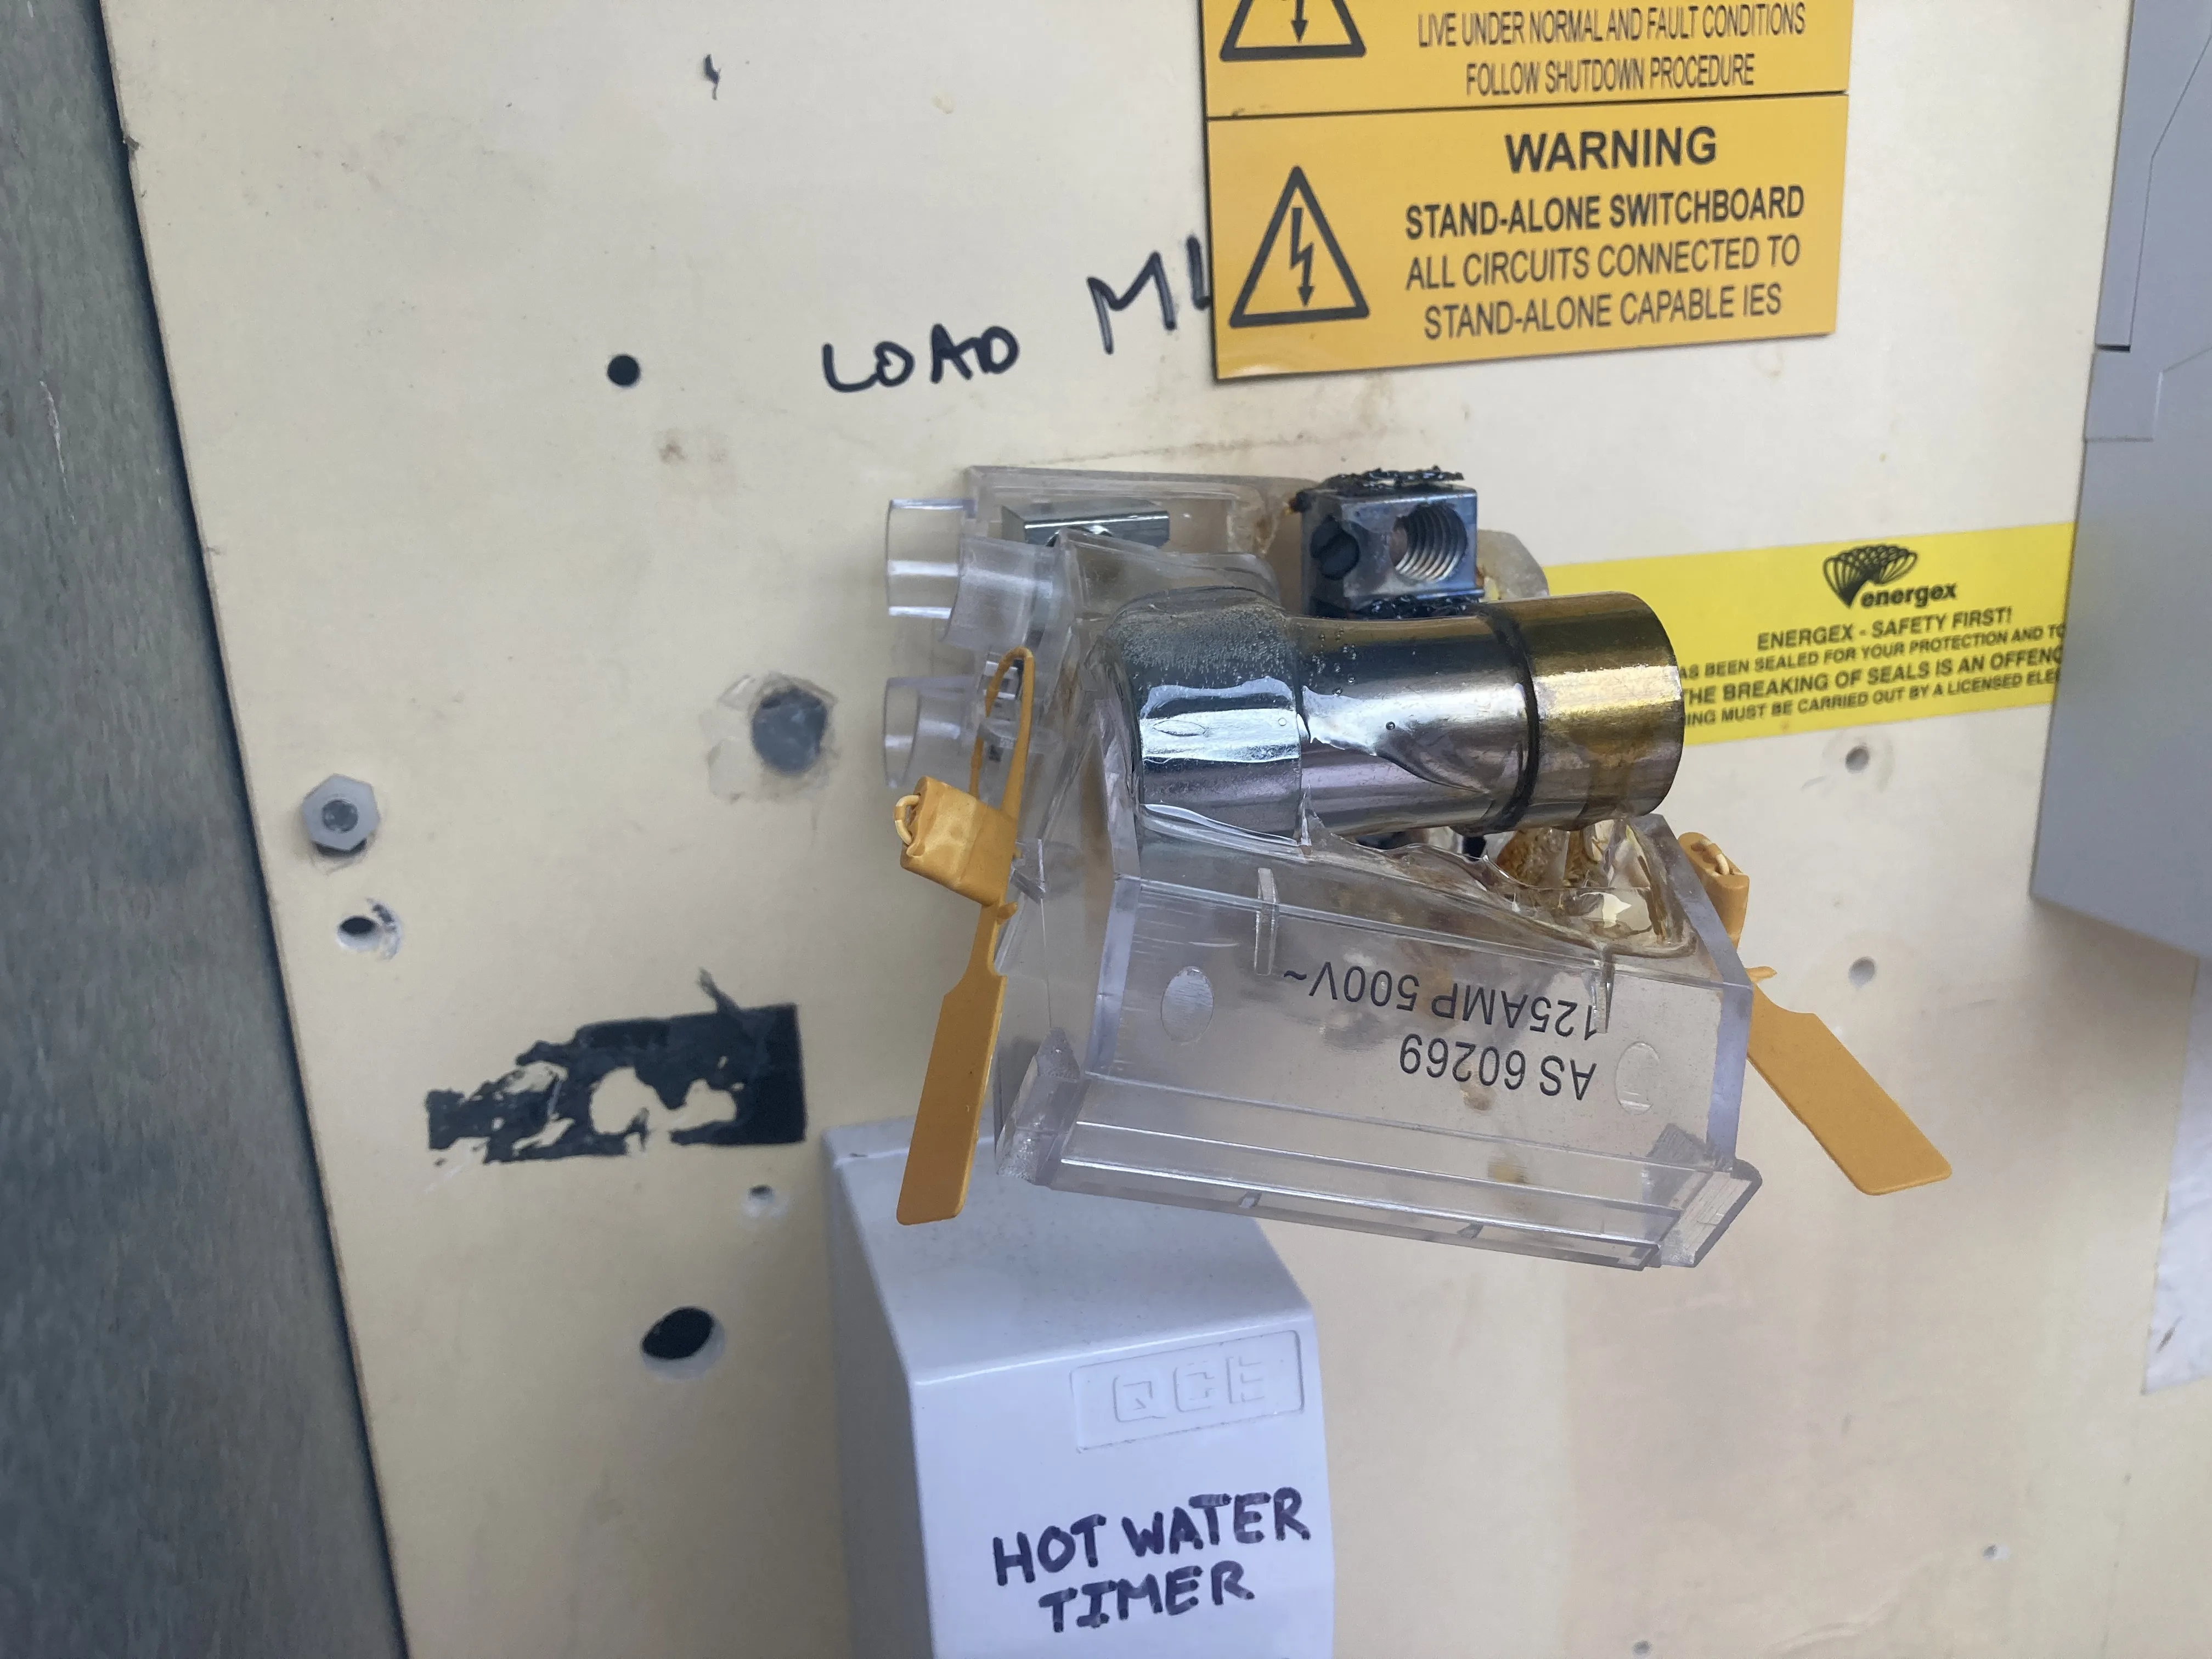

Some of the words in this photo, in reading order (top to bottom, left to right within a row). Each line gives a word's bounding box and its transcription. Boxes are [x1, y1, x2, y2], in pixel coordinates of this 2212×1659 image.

[1418, 12, 1457, 47] LIVE
[1462, 11, 1525, 46] UNDER
[1530, 8, 1604, 44] NORMAL
[1605, 7, 1643, 42] AND
[1647, 5, 1699, 40] FAULT
[1702, 2, 1805, 38] CONDITIONS
[1466, 60, 1540, 96] FOLLOW
[1545, 57, 1644, 93] SHUTDOWN
[1650, 53, 1754, 89] PROCEDURE
[1504, 125, 1716, 173] WARNING
[1405, 195, 1600, 240] STAND-ALONE
[1610, 184, 1804, 229] SWITCHBOARD
[1405, 256, 1455, 290] ALL
[1463, 246, 1589, 286] CIRCUITS
[1598, 236, 1759, 278] CONNECTED
[1767, 233, 1800, 267] TO
[1424, 294, 1612, 340] STAND-ALONE
[1620, 285, 1735, 325] CAPABLE
[1743, 281, 1781, 317] IES
[823, 323, 1019, 392] LOAD
[1860, 582, 1956, 608] energex
[1705, 658, 1749, 678] BEEN
[1754, 650, 1819, 673] SEALED
[1823, 646, 1856, 664] FOR
[1862, 642, 1905, 660] YOUR
[1909, 630, 2008, 655] PROTECTION
[2011, 625, 2044, 642] AND
[1757, 623, 1853, 651] ENERGEX
[1872, 612, 1946, 639] SAFETY
[1952, 606, 2012, 629] FIRST!
[1684, 710, 1716, 728] ING
[1722, 703, 1767, 723] MUST
[1771, 701, 1793, 716] BE
[1797, 691, 1869, 713] CARRIED
[1872, 686, 1905, 704] OUT
[1909, 684, 1927, 700] BY
[1932, 682, 1944, 697] A
[1947, 675, 2023, 696] LICENSED
[1723, 672, 1829, 702] BREAKING
[1835, 668, 1863, 689] OF
[1867, 660, 1929, 686] SEALS
[1936, 657, 1953, 677] IS
[1957, 653, 1984, 674] AN
[1431, 983, 1596, 1041] 125AMP
[1400, 1033, 1526, 1090] 60269
[1539, 1055, 1597, 1101] AS
[992, 1514, 1107, 1586] HOT
[1121, 1487, 1311, 1557] WATER
[1038, 1560, 1255, 1633] TIMER
